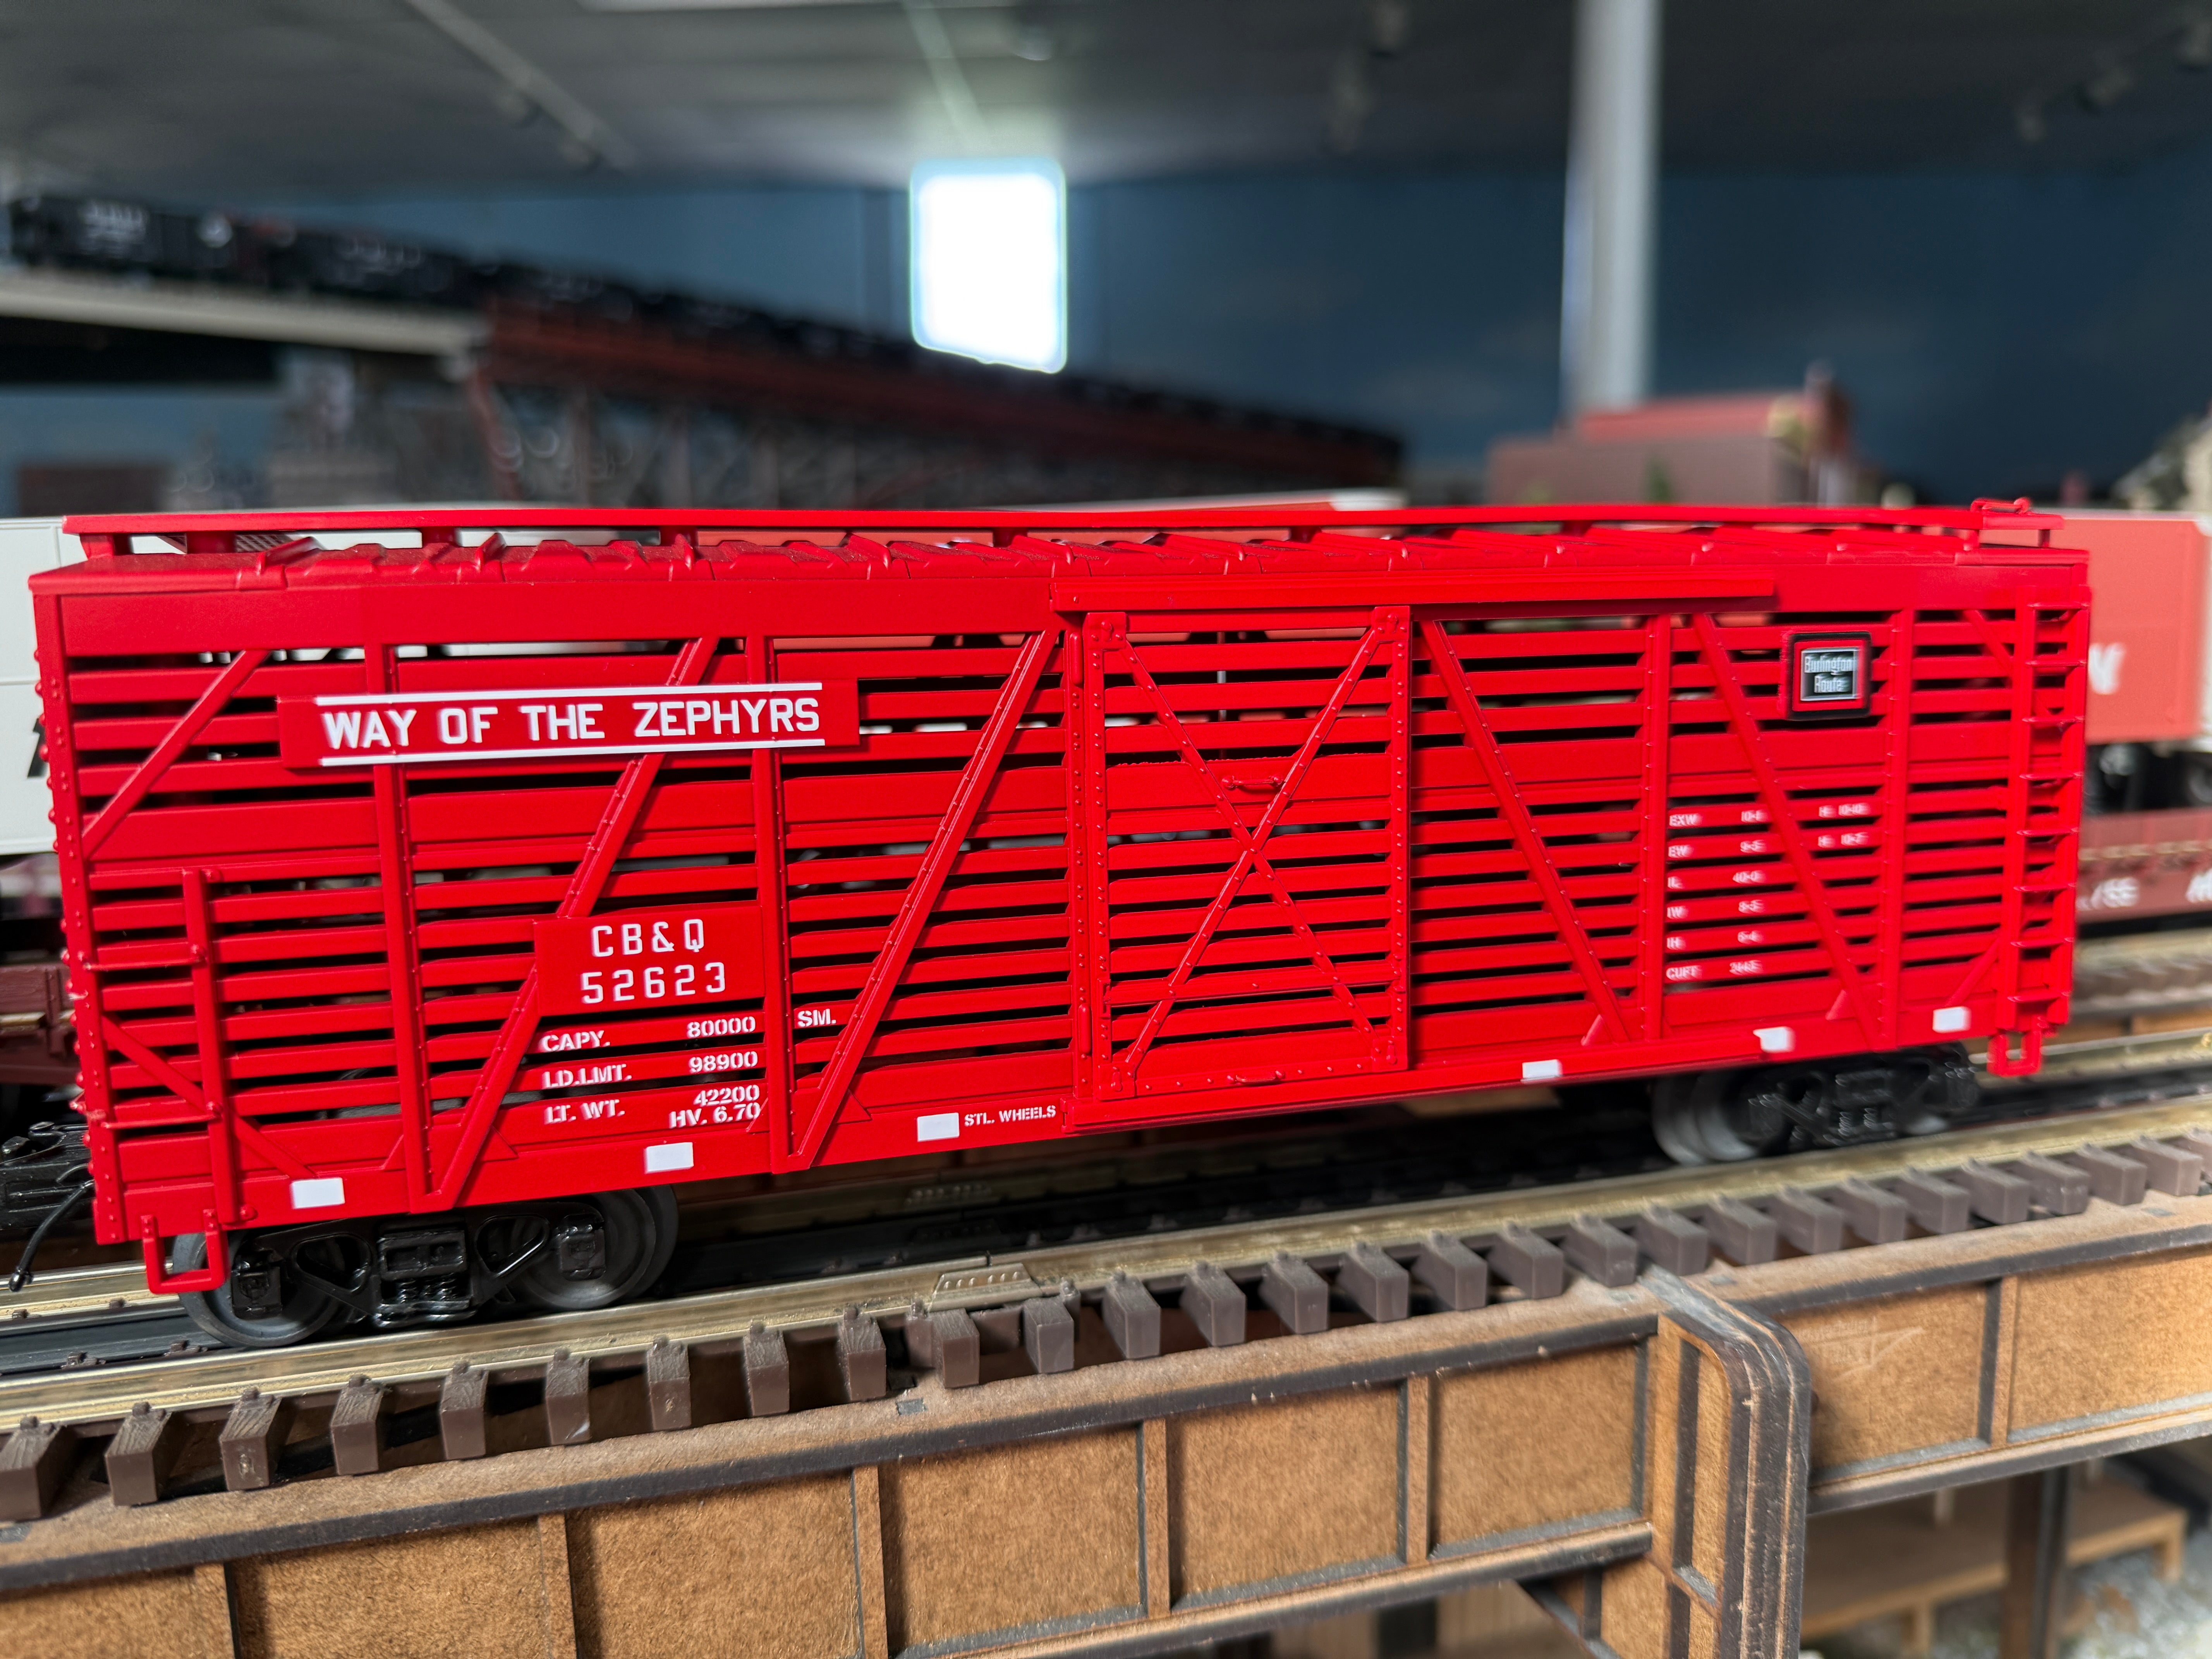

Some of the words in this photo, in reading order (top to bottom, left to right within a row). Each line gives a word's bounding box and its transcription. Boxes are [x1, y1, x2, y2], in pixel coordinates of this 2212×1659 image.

[1805, 655, 1857, 675] Burlington
[1814, 675, 1850, 693] Route
[322, 709, 415, 750] WAY
[438, 706, 499, 745] OF
[518, 704, 606, 740] THE
[633, 697, 820, 737] ZEPHYRS
[1669, 813, 1701, 827] EXW
[1668, 844, 1692, 858] EW
[1667, 876, 1682, 889] IL
[1666, 905, 1686, 919] IW
[591, 918, 704, 958] CB&Q
[1666, 936, 1684, 950] IH
[581, 962, 726, 1004] 52623
[540, 1030, 611, 1053] CAPY.
[687, 1016, 756, 1038] 80000
[797, 1008, 837, 1028] SM.
[689, 1051, 758, 1073] 98900
[545, 1104, 577, 1124] LT.
[581, 1099, 625, 1120] WT.
[693, 1084, 761, 1109] 42200
[713, 1101, 761, 1123] 6.70
[964, 1112, 995, 1127] STL.
[998, 1105, 1056, 1123] WHEELS
